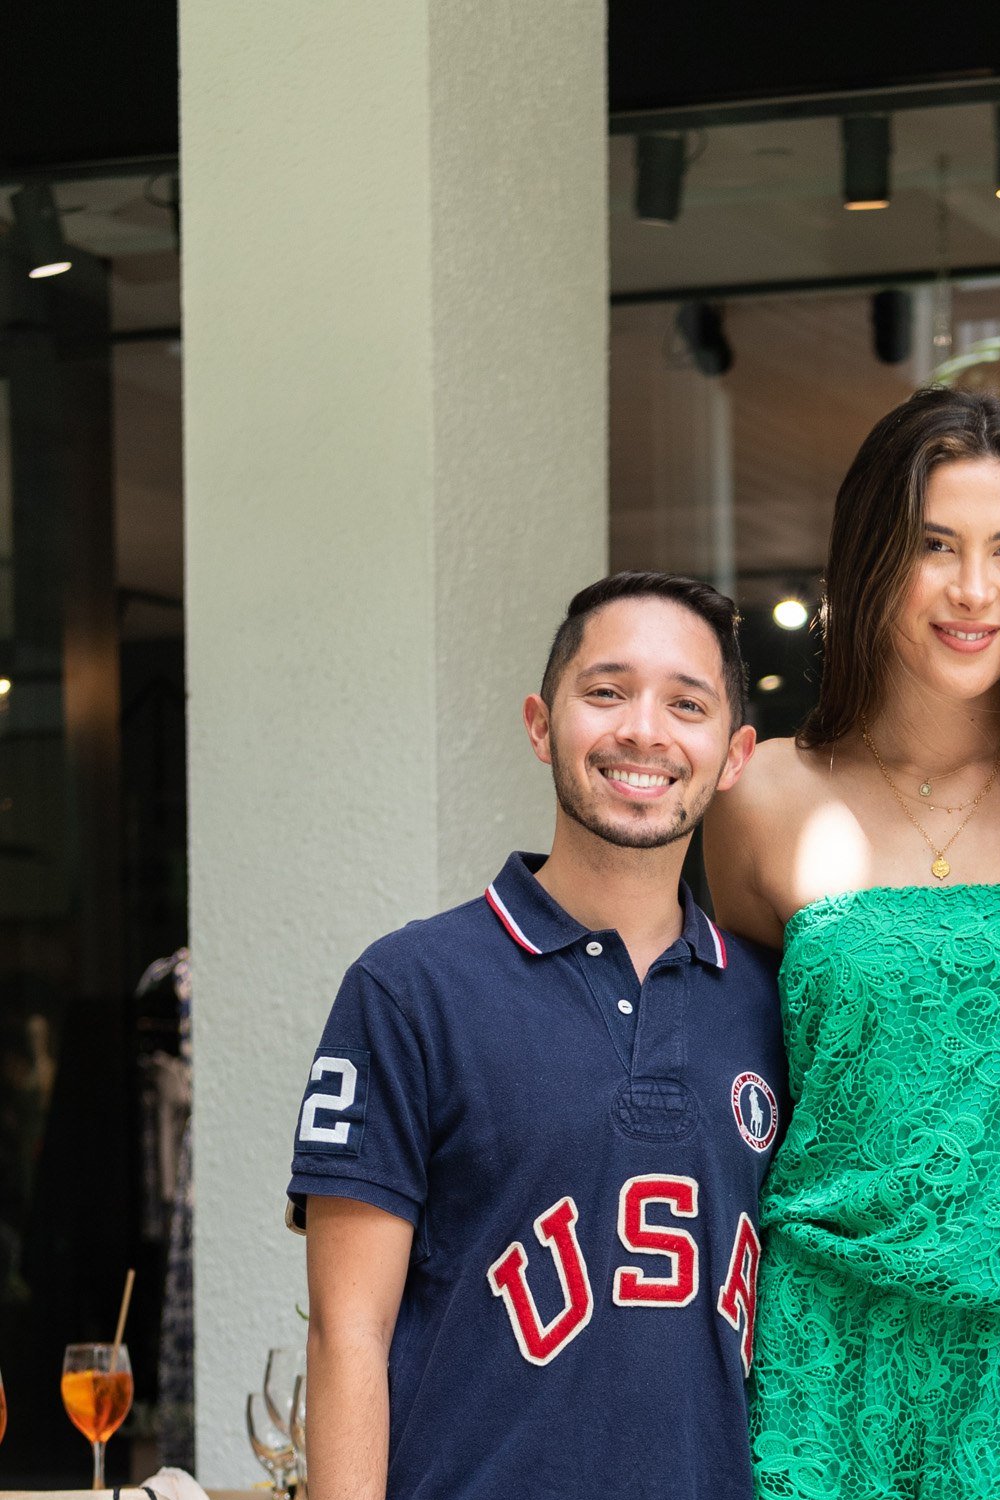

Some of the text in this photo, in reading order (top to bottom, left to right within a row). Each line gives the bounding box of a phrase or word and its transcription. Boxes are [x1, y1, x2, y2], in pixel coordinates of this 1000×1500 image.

[299, 1056, 358, 1145] 2
[734, 1074, 769, 1107] RALPH LAUREN
[487, 1173, 761, 1377] USA
